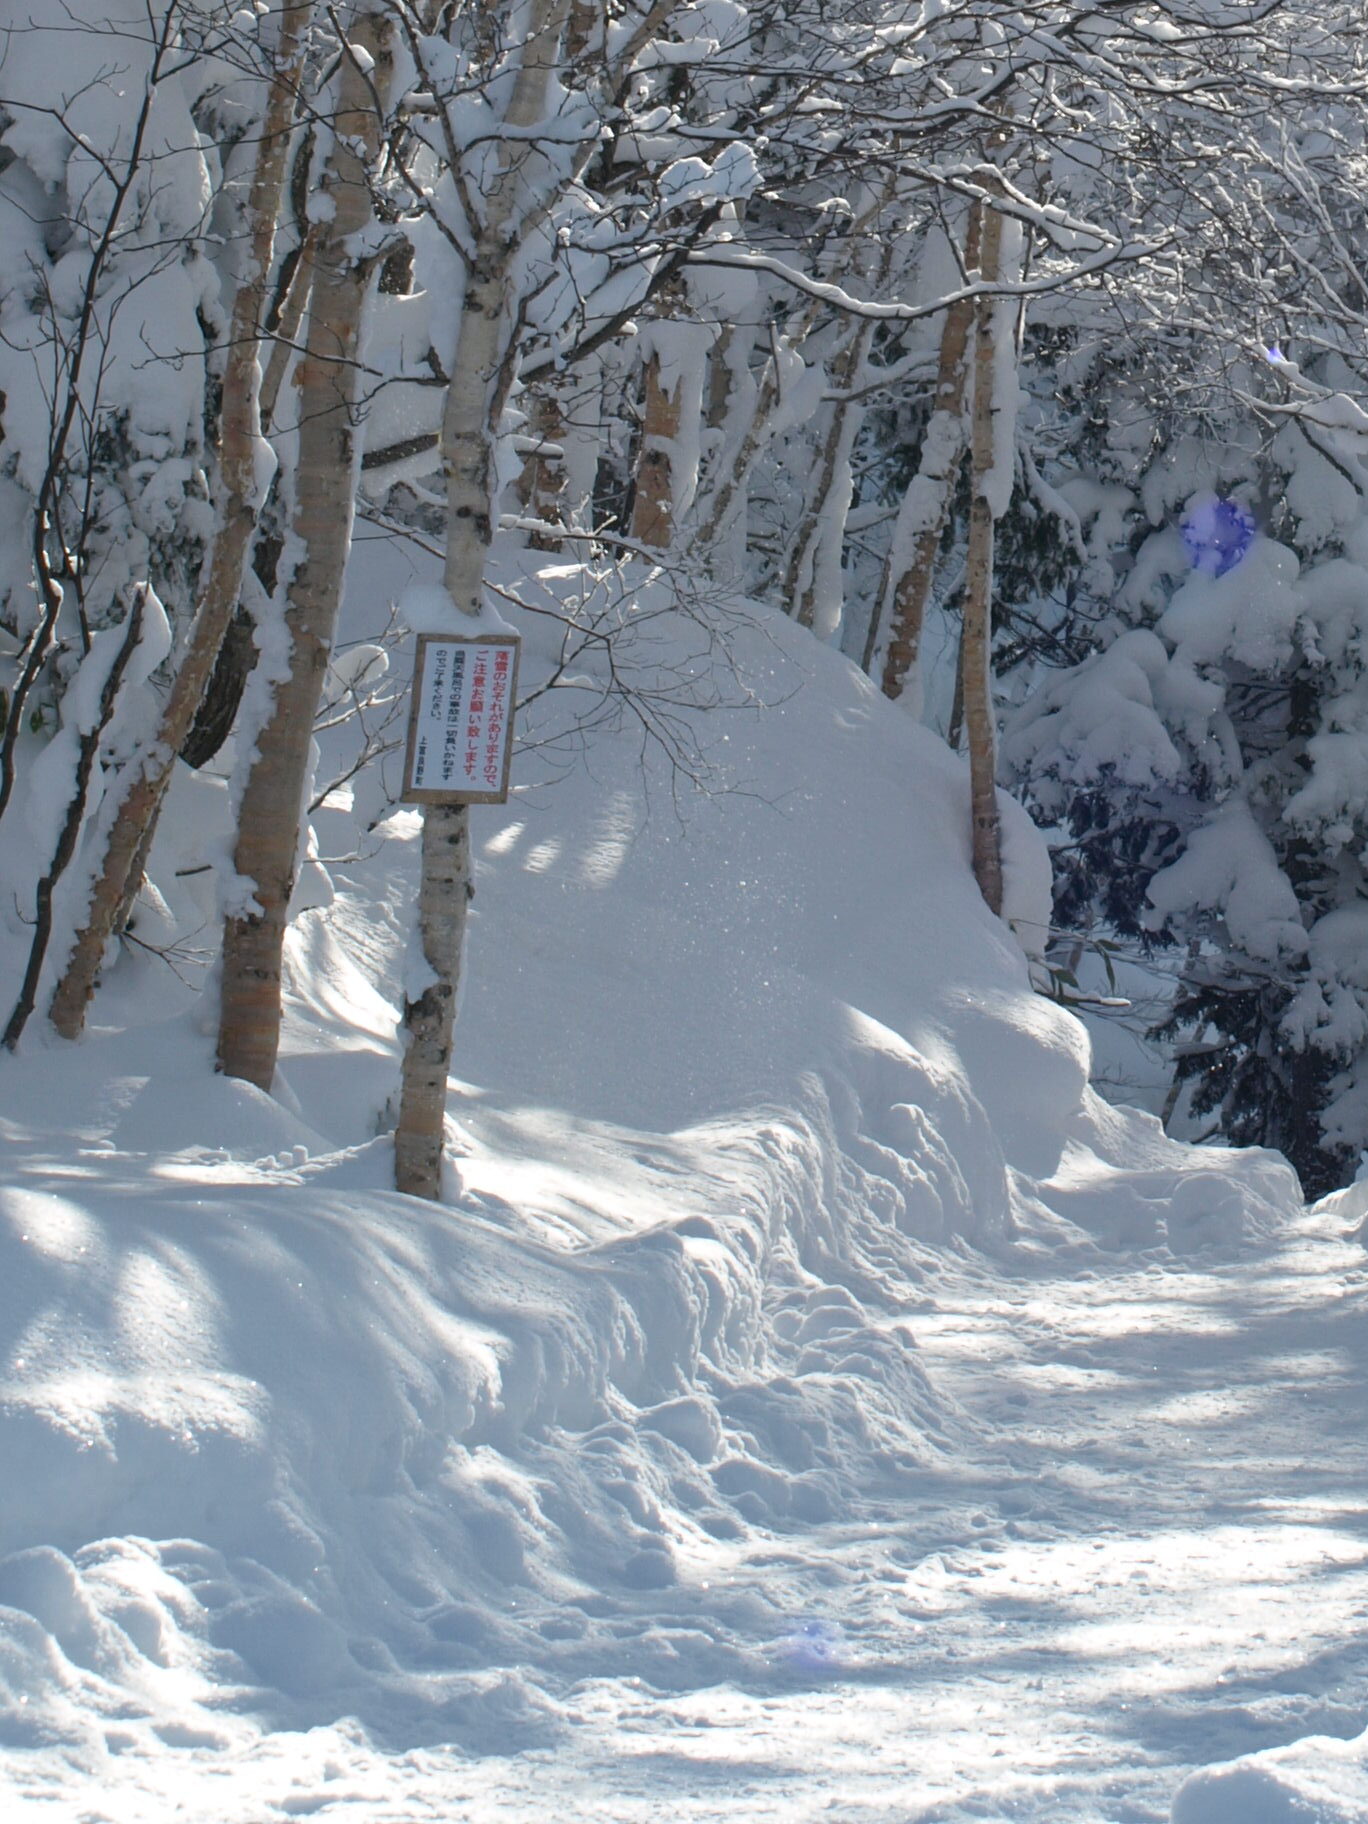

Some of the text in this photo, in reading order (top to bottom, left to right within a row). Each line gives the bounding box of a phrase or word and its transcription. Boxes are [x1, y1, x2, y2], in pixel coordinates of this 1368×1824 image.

[463, 650, 489, 781] ご注意お願い致します。
